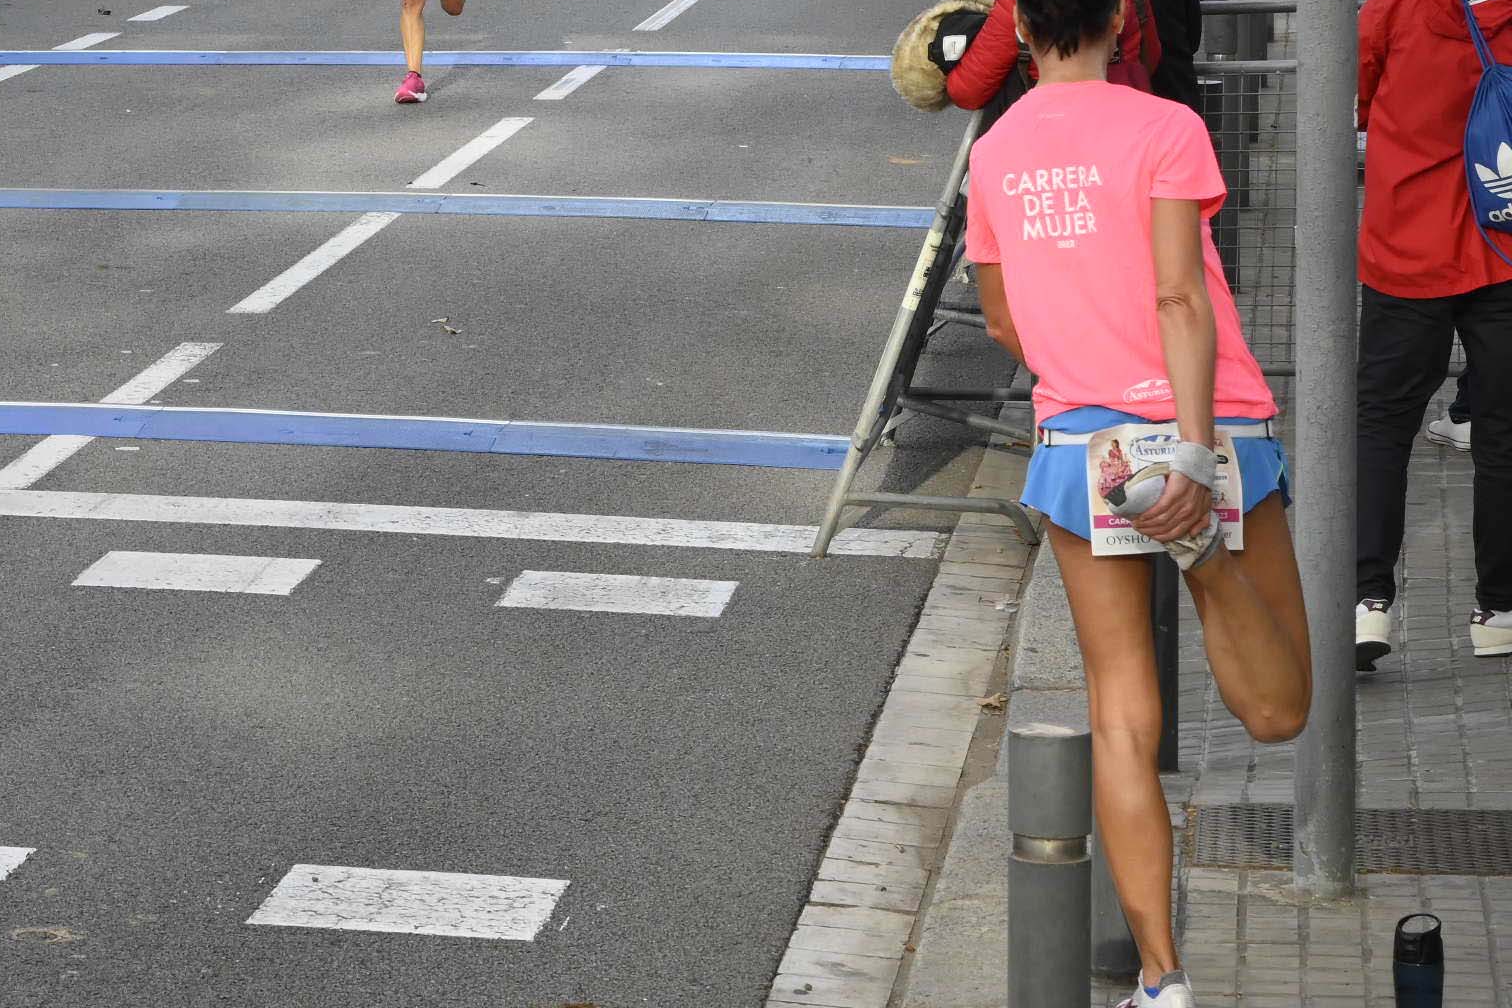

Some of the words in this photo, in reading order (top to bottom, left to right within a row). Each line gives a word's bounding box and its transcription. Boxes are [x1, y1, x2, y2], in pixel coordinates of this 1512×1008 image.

[1002, 165, 1103, 196] CARRERA
[1023, 192, 1055, 217] DE
[1064, 189, 1090, 212] LA
[1489, 202, 1512, 224] ad
[1022, 212, 1097, 241] MUJER
[1106, 534, 1152, 546] OYSHO
